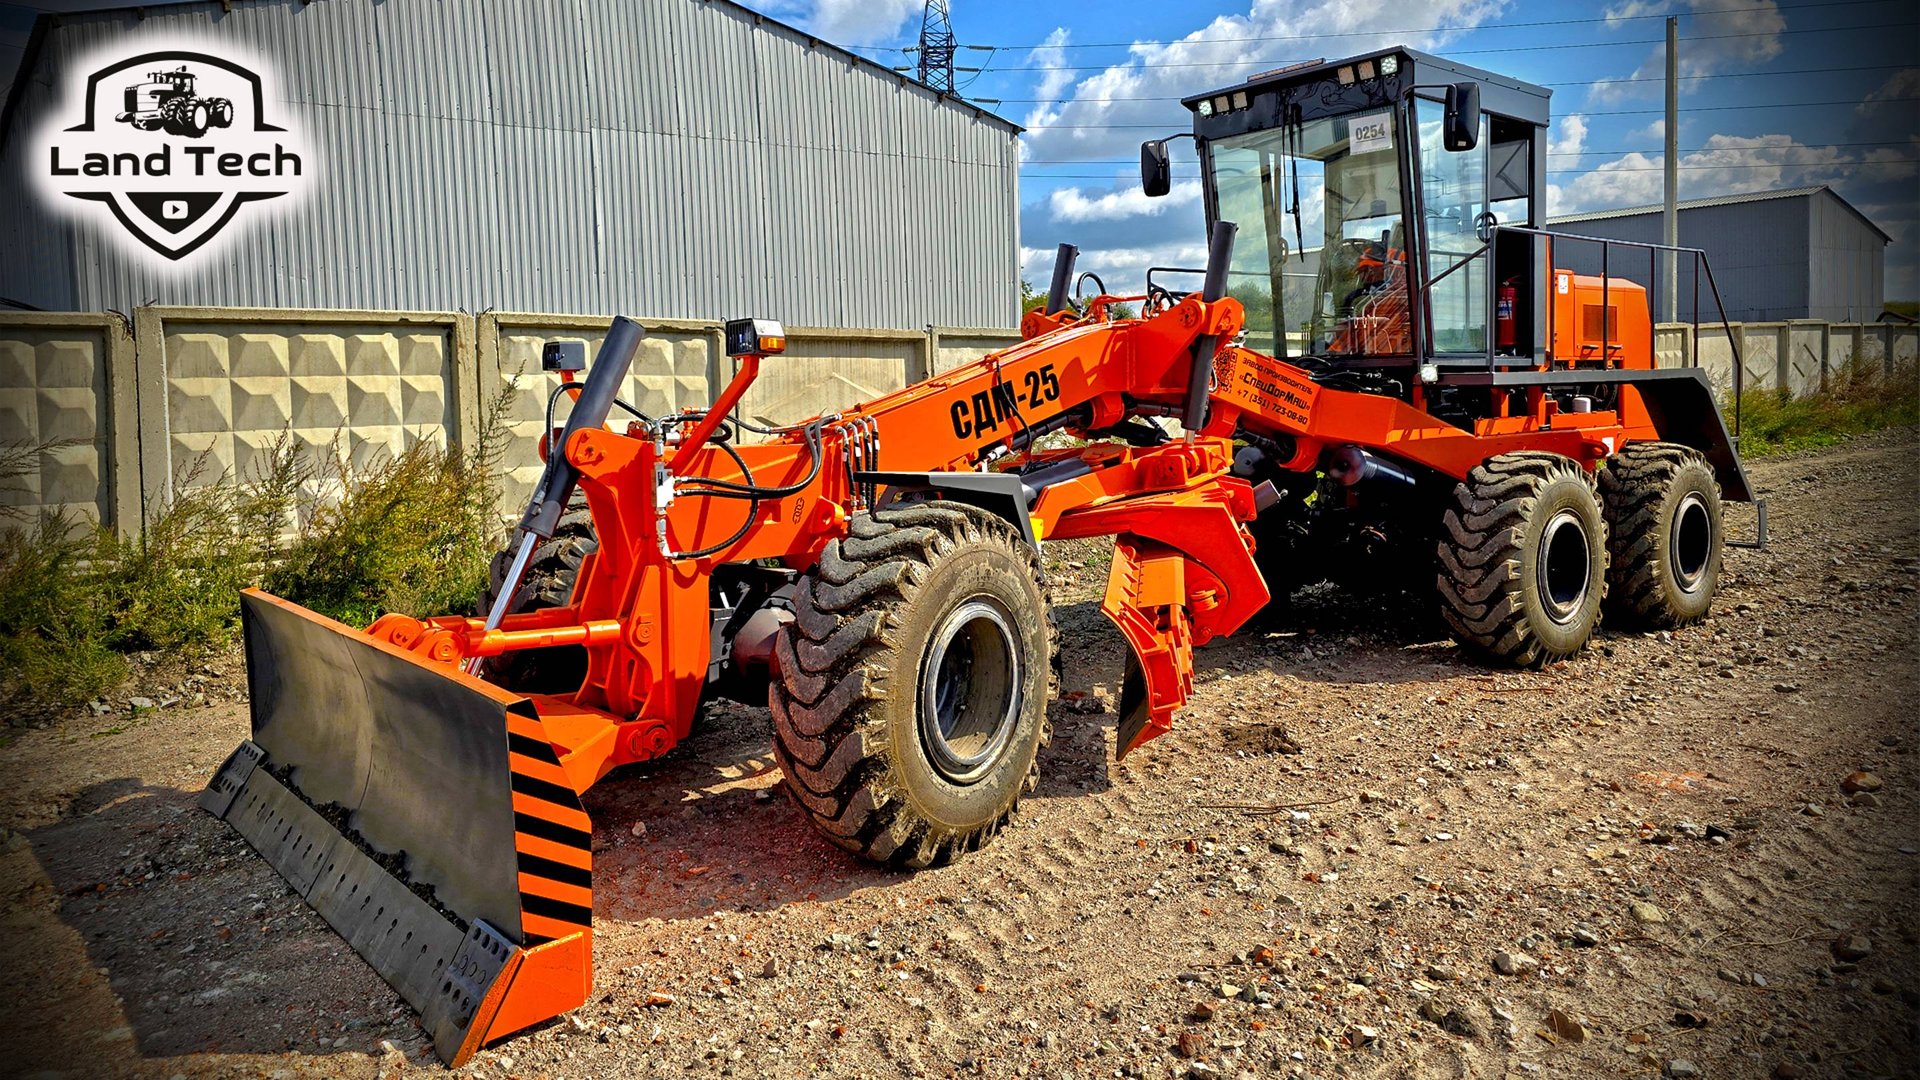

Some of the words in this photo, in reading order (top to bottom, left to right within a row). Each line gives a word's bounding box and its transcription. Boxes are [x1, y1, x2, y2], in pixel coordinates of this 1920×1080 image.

[1355, 123, 1386, 141] 0254
[950, 363, 1060, 440] СДМ-25
[1249, 393, 1270, 409] (351)
